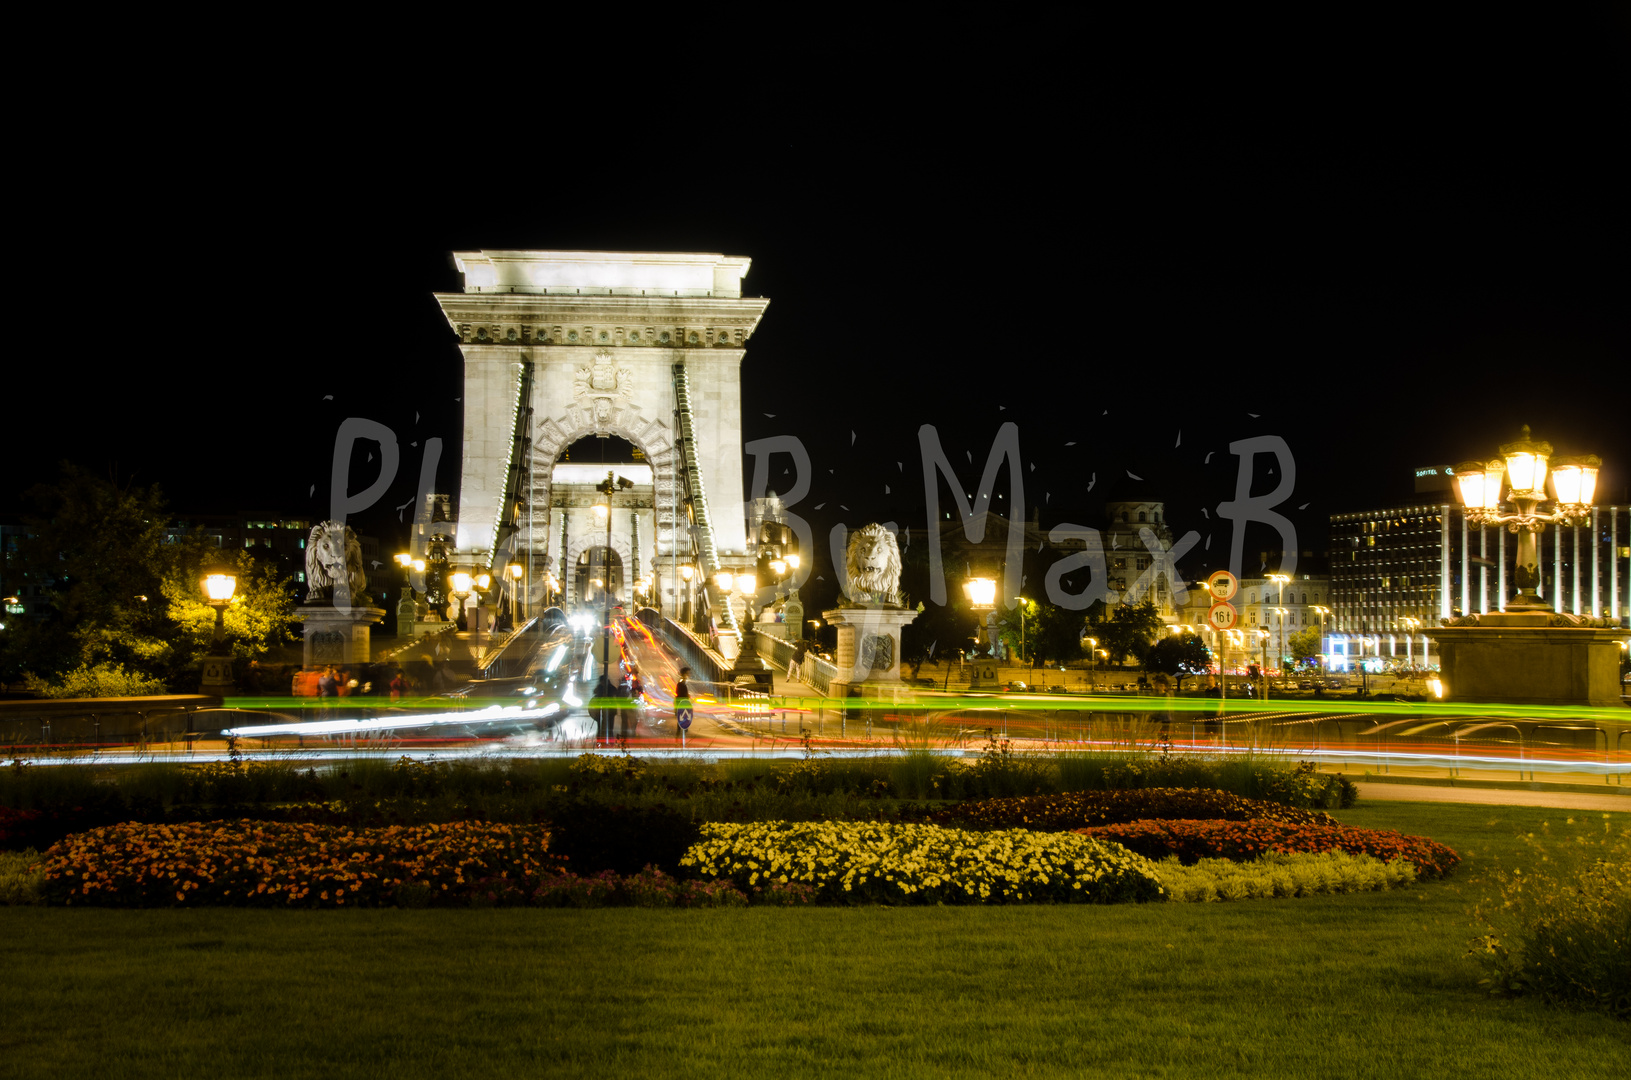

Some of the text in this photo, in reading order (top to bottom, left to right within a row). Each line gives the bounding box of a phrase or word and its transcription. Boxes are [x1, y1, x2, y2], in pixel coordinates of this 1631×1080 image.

[1416, 469, 1438, 477] SOFITEL
[1215, 611, 1232, 623] 16 t
